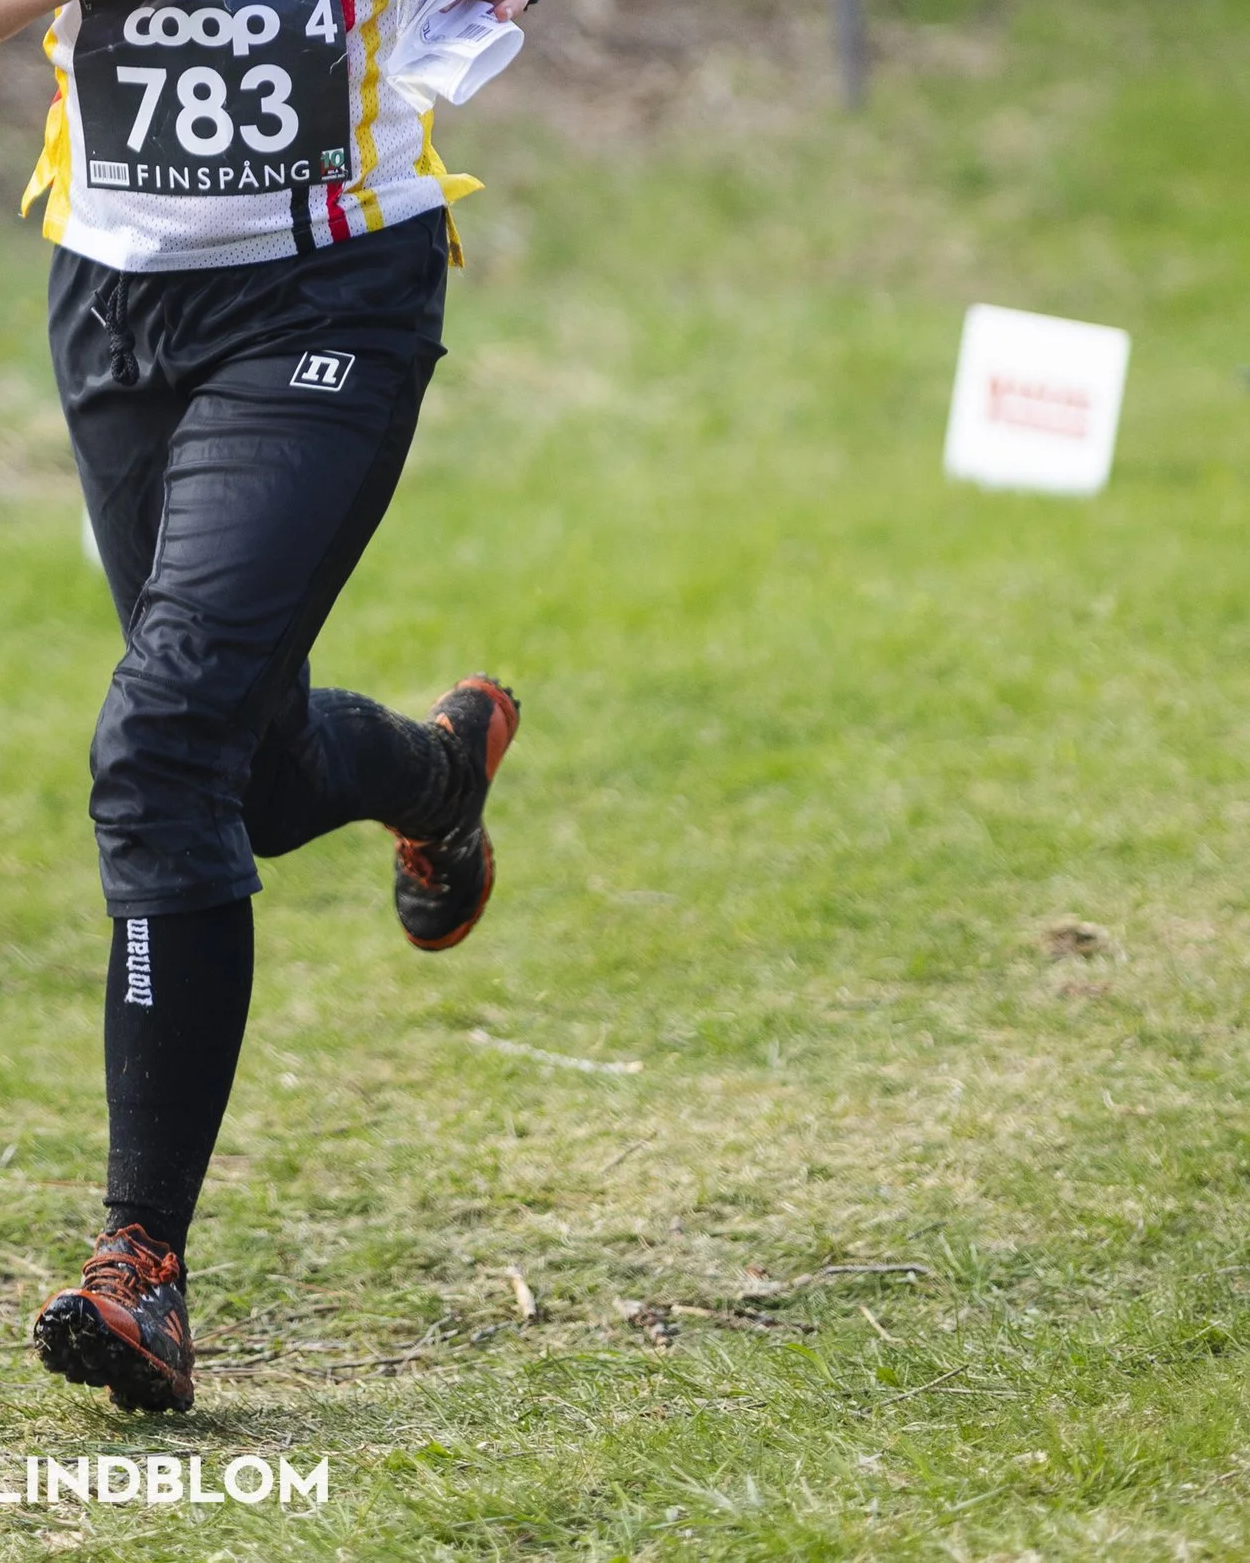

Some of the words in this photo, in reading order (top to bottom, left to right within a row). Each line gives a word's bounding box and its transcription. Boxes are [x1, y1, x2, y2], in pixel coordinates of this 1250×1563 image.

[123, 4, 281, 56] coop
[116, 64, 299, 156] 783
[136, 160, 310, 190] FINSPÅNG
